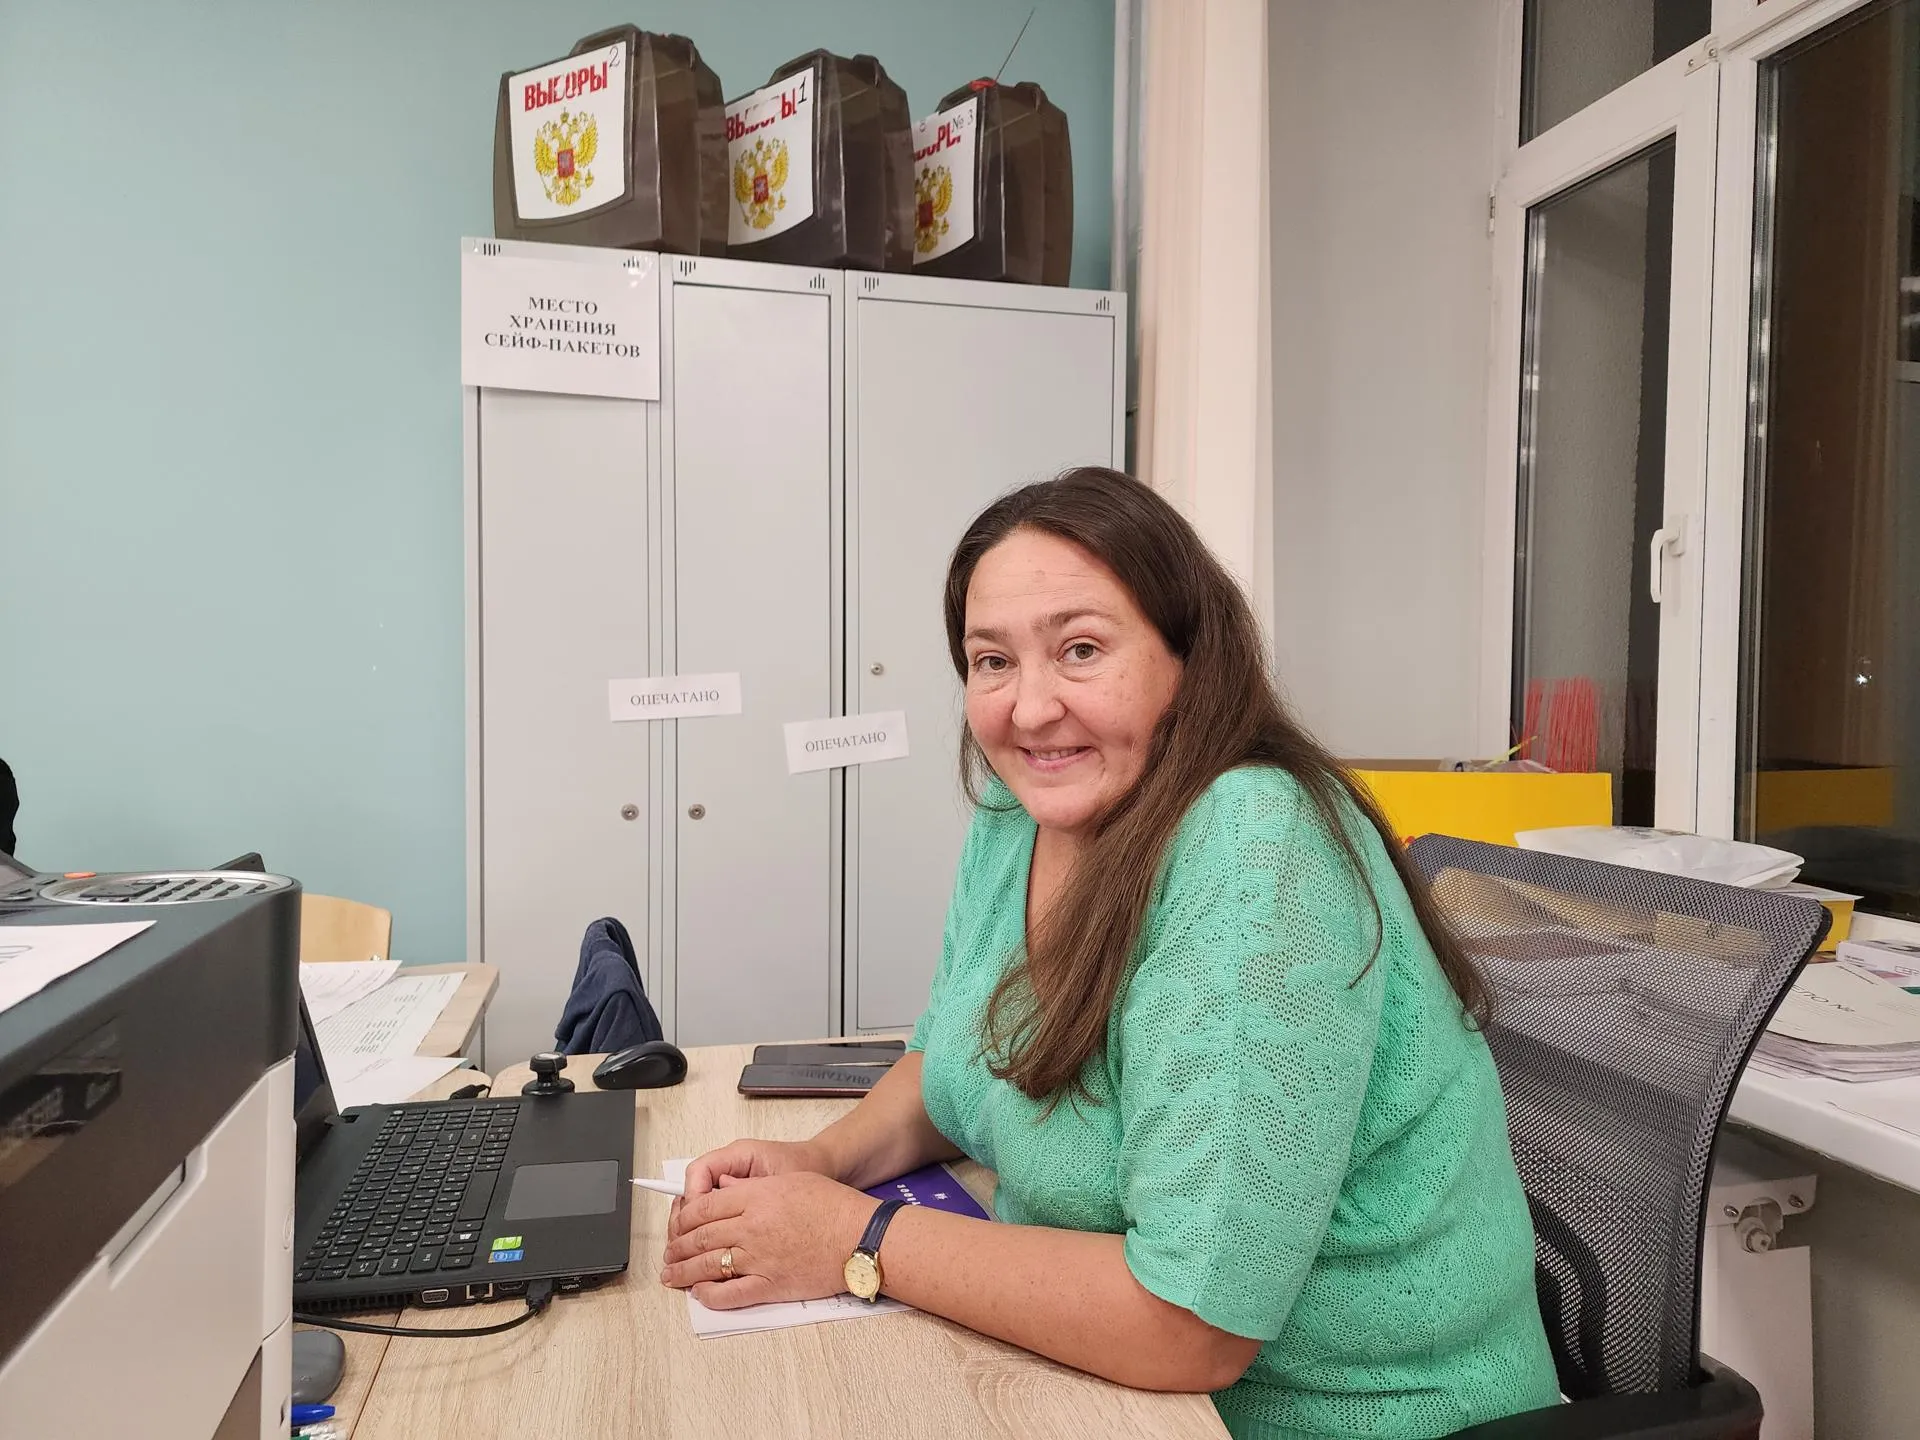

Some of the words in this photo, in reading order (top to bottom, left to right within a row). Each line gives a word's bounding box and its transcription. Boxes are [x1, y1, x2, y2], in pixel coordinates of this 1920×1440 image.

[608, 45, 621, 69] 2
[798, 76, 808, 105] 1
[967, 108, 974, 126] 3
[529, 296, 598, 316] МЕСТО
[510, 314, 616, 337] ХРАНЕНИЯ
[484, 331, 641, 359] СЕЙФ-ПАКЕТОВ
[630, 689, 720, 706] ОПЕЧАТАНО
[804, 730, 888, 753] ОПЕЧАТАНО
